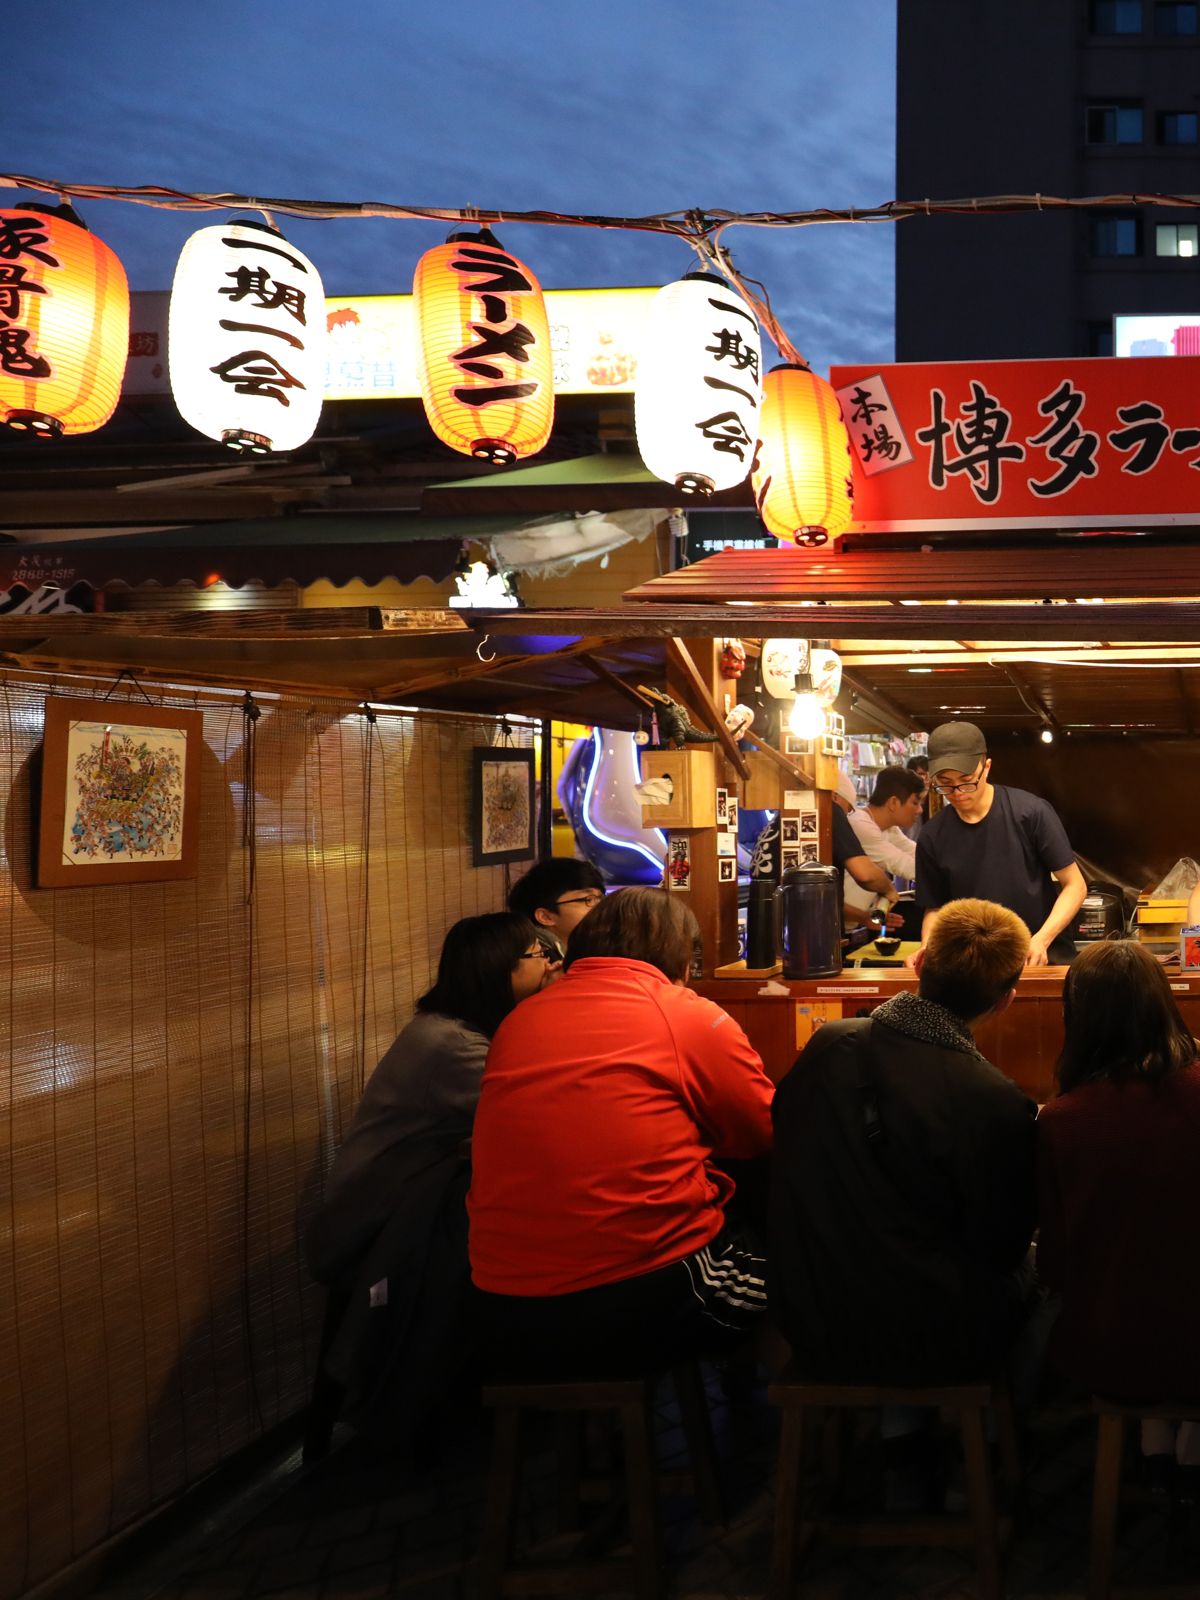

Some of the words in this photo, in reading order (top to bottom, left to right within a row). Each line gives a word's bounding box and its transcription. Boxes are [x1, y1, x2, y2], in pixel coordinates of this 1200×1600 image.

[209, 237, 308, 408] 一期一会
[451, 248, 539, 406] ラーメン
[695, 298, 759, 463] 一期一会
[850, 387, 902, 463] 本場
